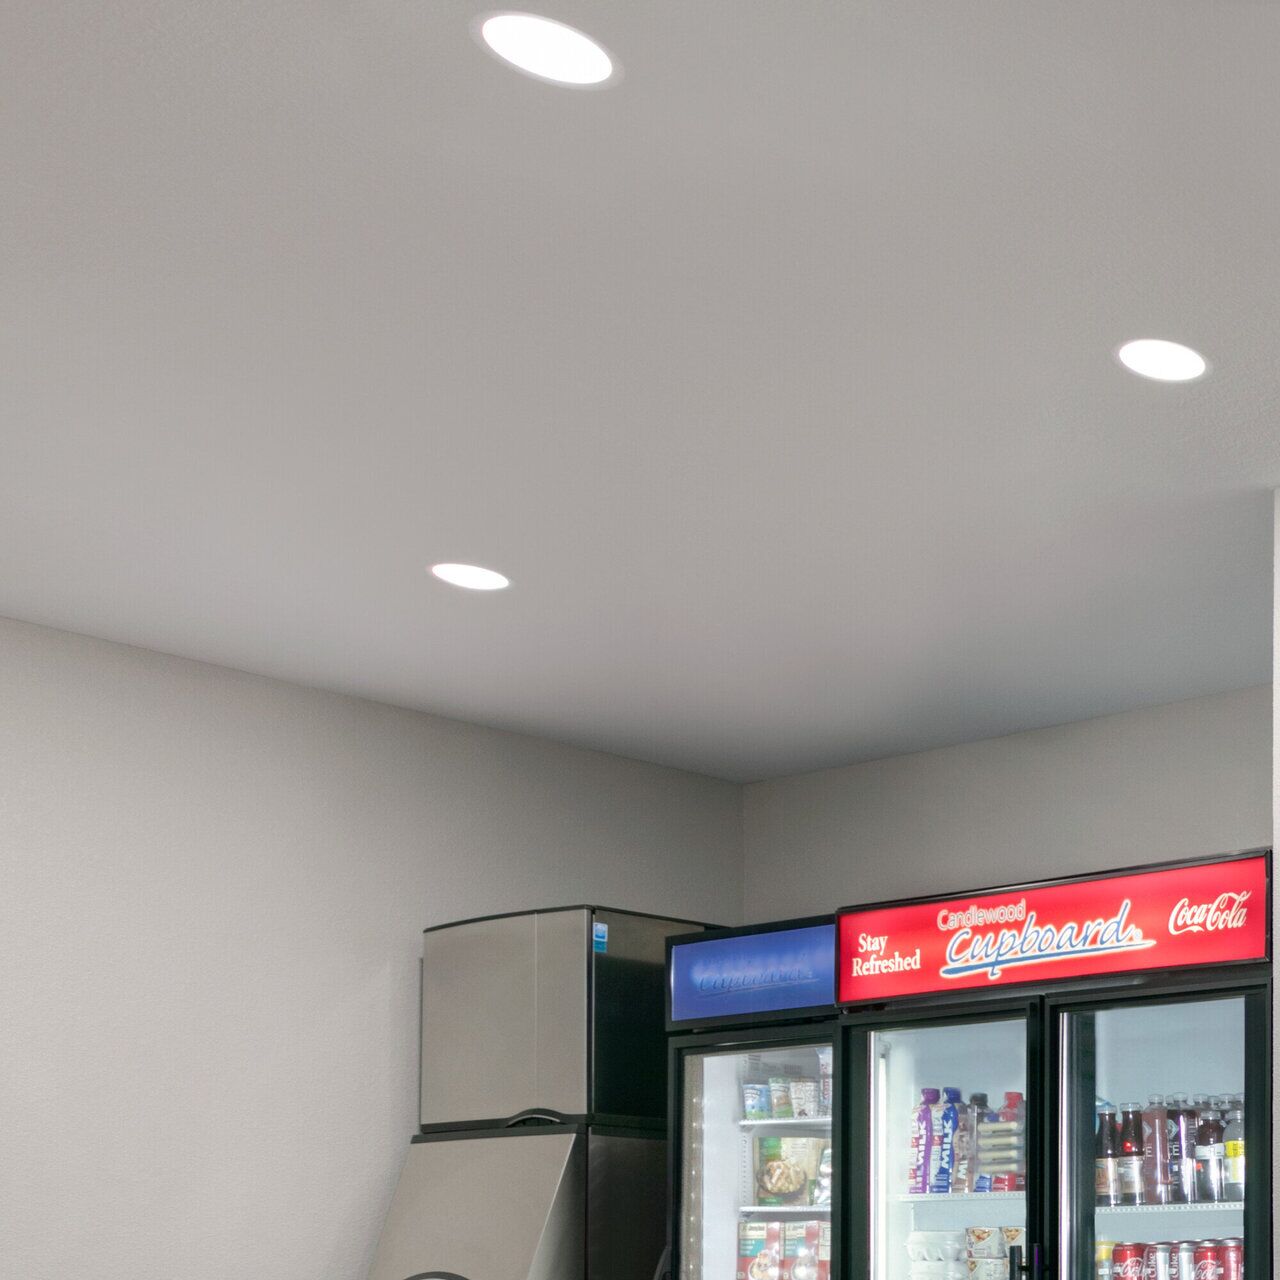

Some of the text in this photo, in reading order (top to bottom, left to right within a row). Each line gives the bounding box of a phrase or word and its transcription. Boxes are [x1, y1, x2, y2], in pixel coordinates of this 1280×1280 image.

[937, 898, 1026, 931] Candlewood
[1168, 890, 1252, 935] Coca-Cola
[858, 933, 888, 955] Stay
[946, 899, 1134, 979] Cupboard
[852, 949, 921, 976] Refreshed
